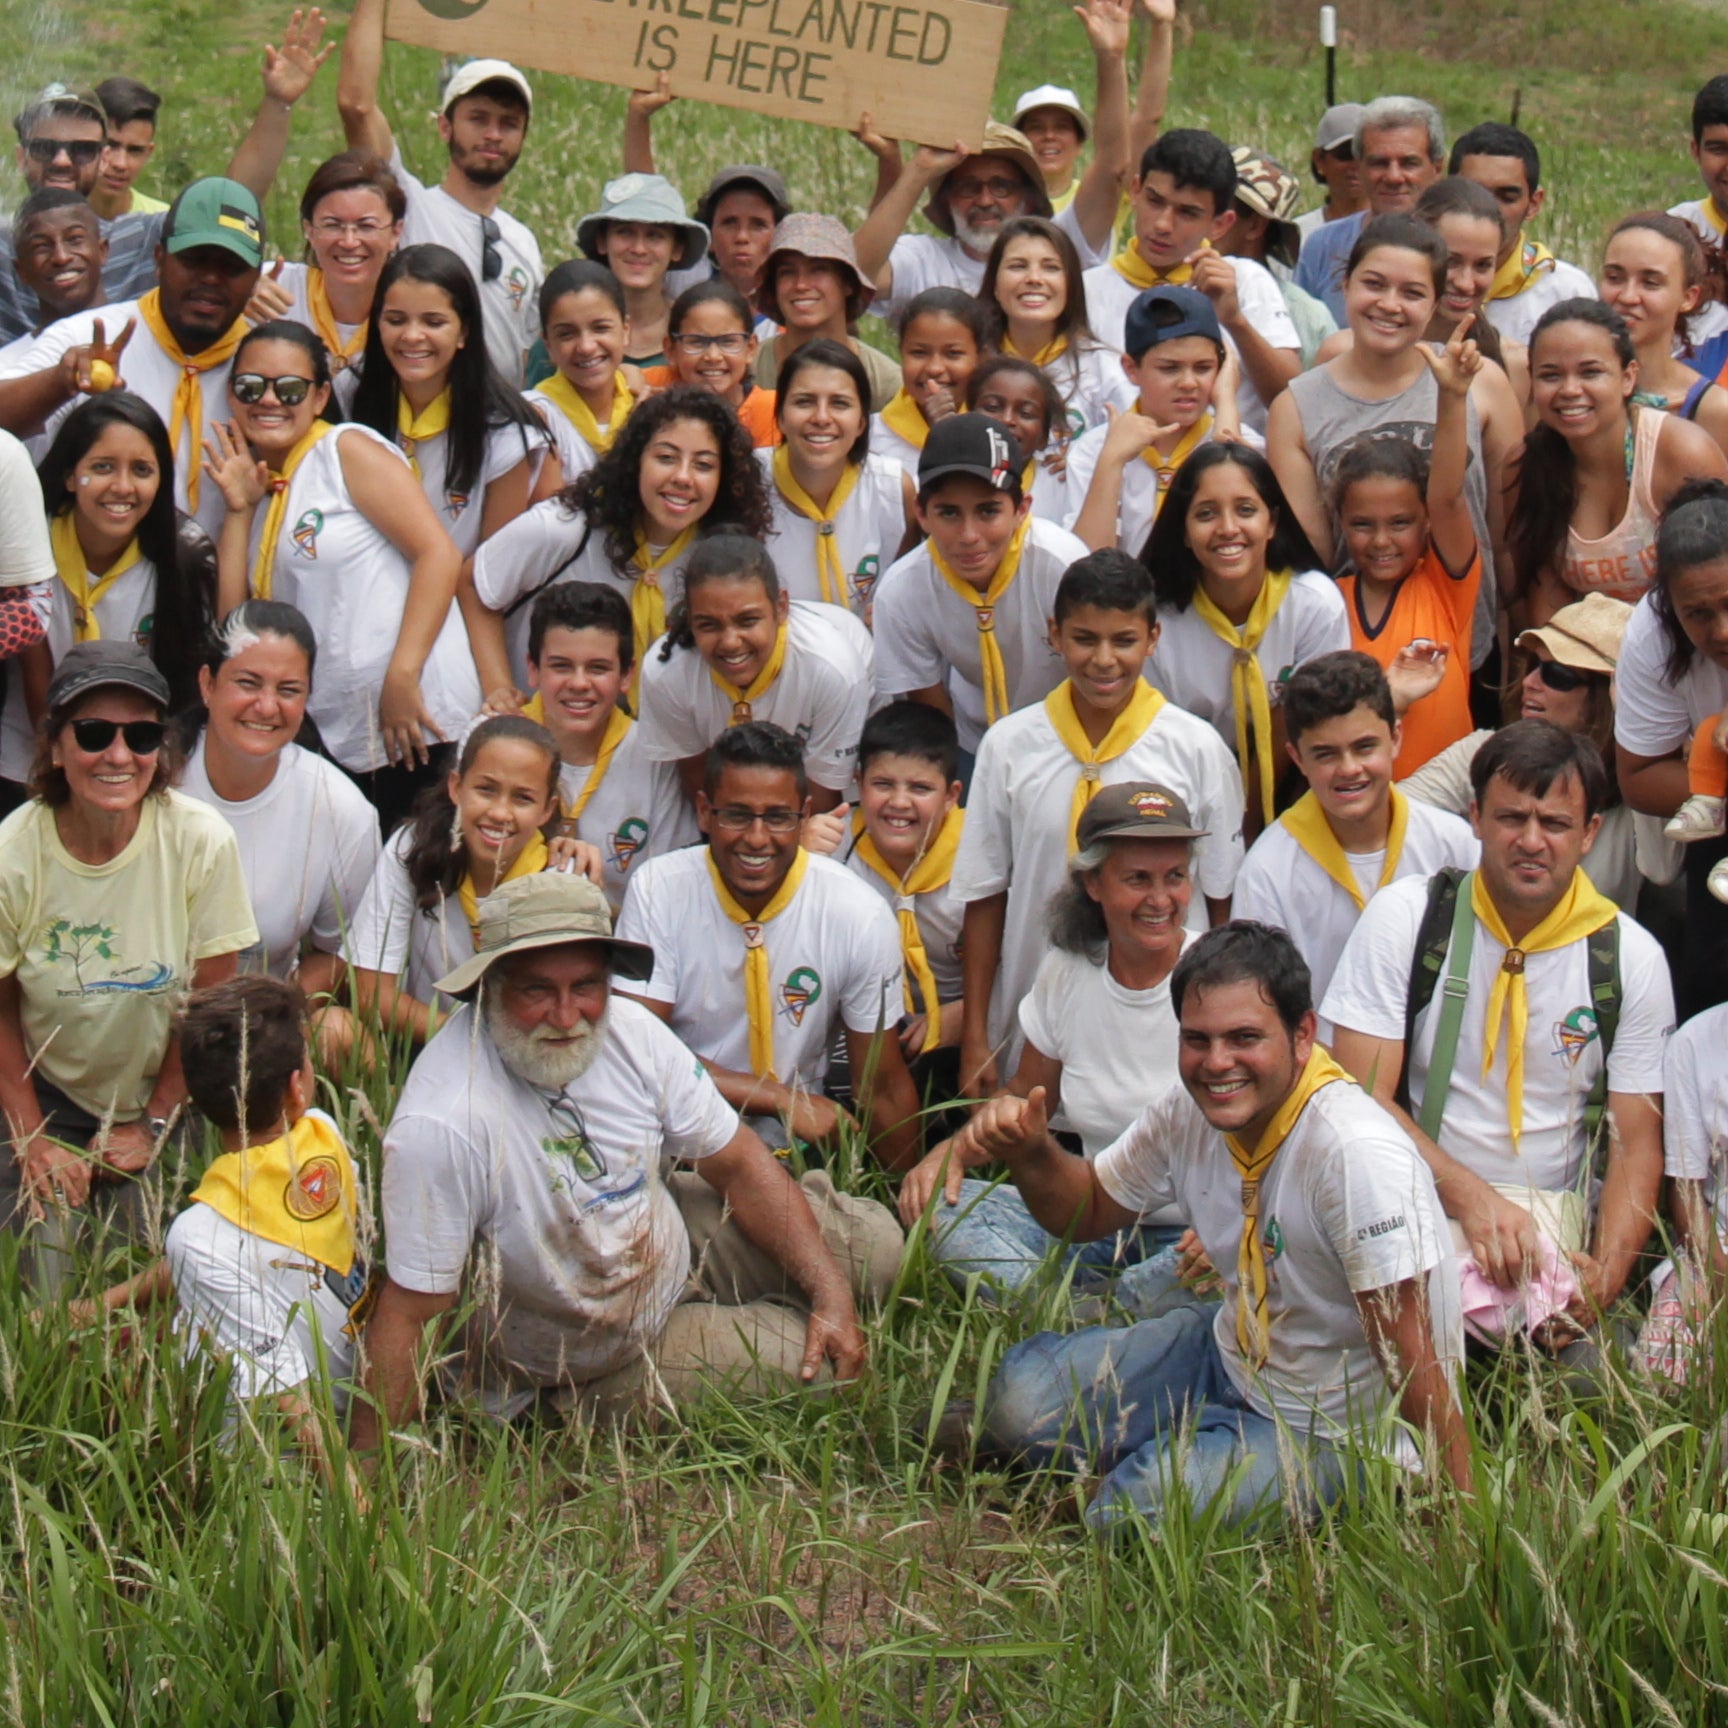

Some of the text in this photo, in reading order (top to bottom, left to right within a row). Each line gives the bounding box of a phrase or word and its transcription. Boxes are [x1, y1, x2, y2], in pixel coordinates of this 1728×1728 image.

[633, 20, 833, 104] IS HERE
[1563, 556, 1637, 586] HERE
